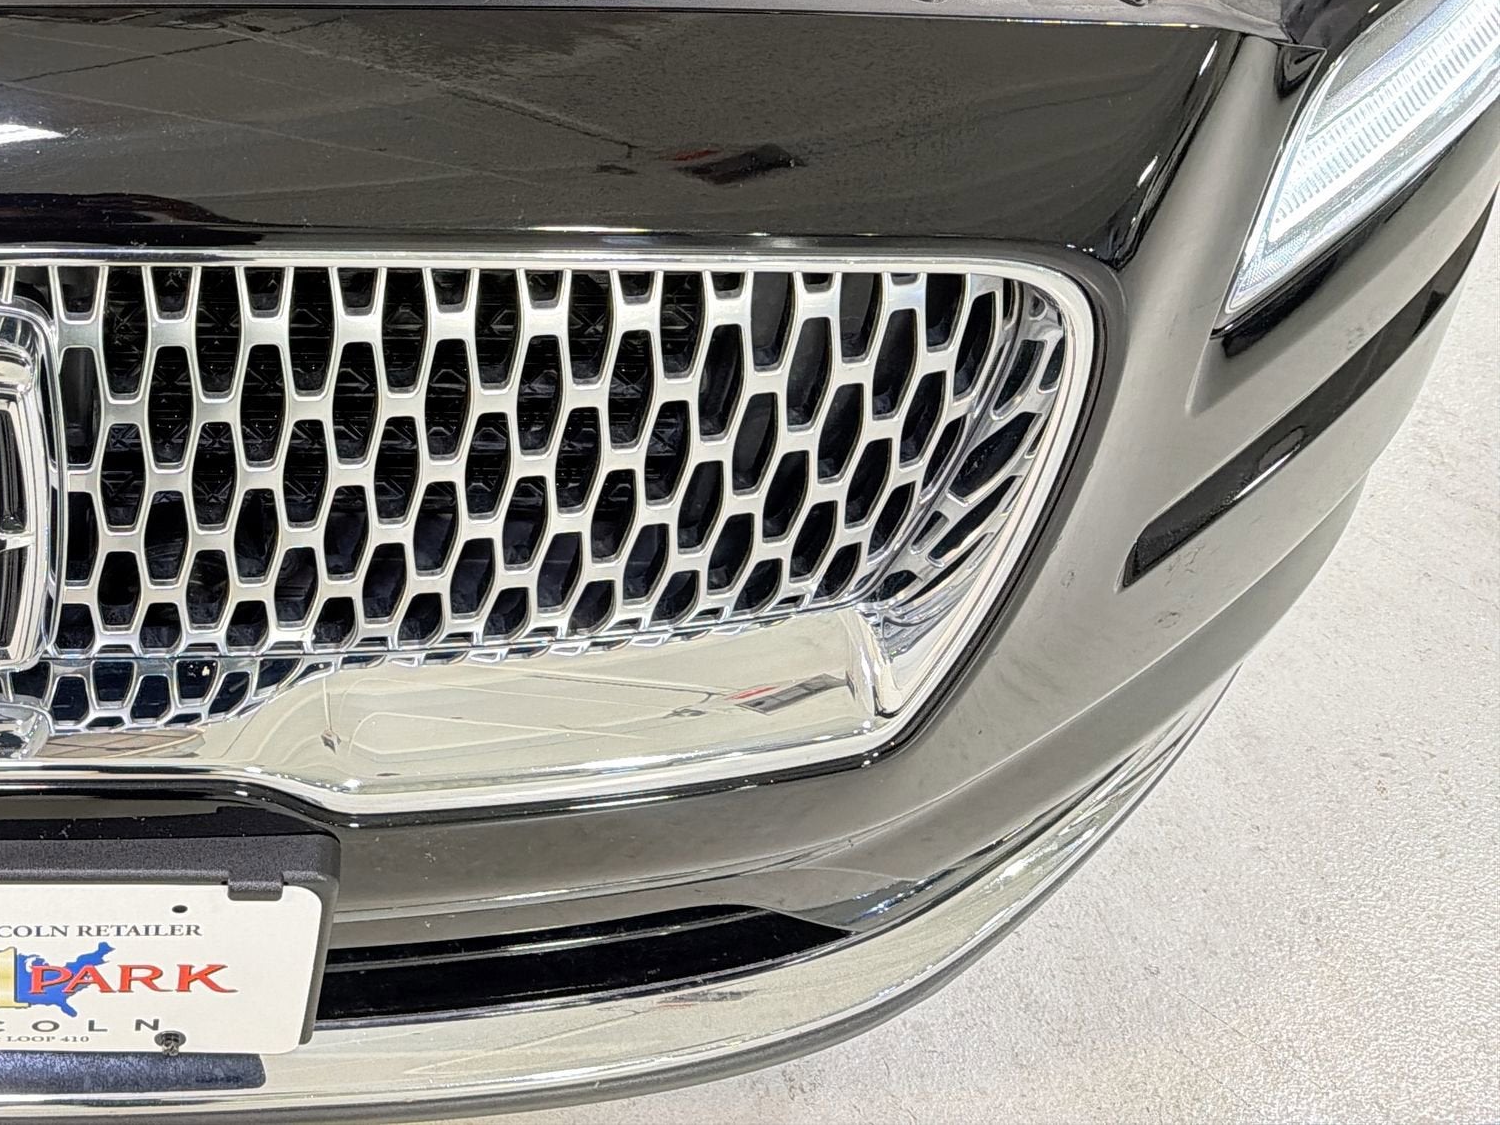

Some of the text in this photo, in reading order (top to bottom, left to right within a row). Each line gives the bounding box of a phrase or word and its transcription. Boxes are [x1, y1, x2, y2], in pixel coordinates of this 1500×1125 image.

[75, 923, 203, 938] RETAILER
[29, 963, 239, 995] PARK
[6, 1034, 56, 1044] LOOP
[61, 1034, 91, 1044] 410
